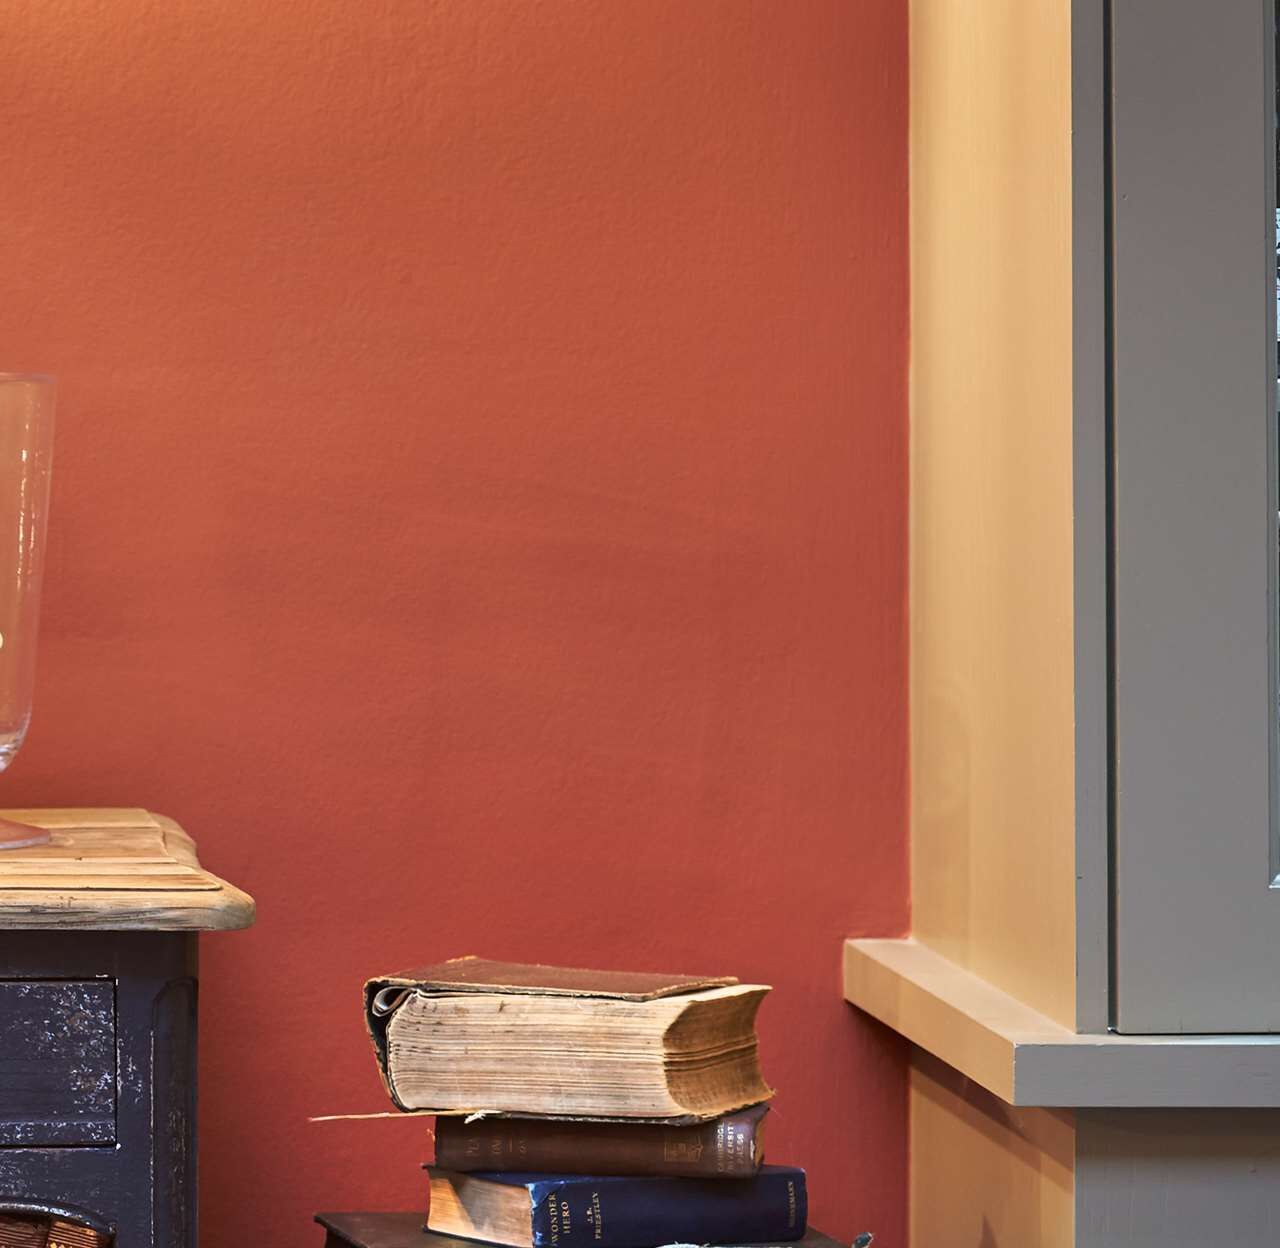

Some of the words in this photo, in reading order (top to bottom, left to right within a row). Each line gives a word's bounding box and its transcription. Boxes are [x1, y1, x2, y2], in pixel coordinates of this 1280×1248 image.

[547, 1192, 558, 1246] WONDER
[561, 1200, 570, 1234] HERO
[593, 1191, 602, 1239] PRIESTLEY
